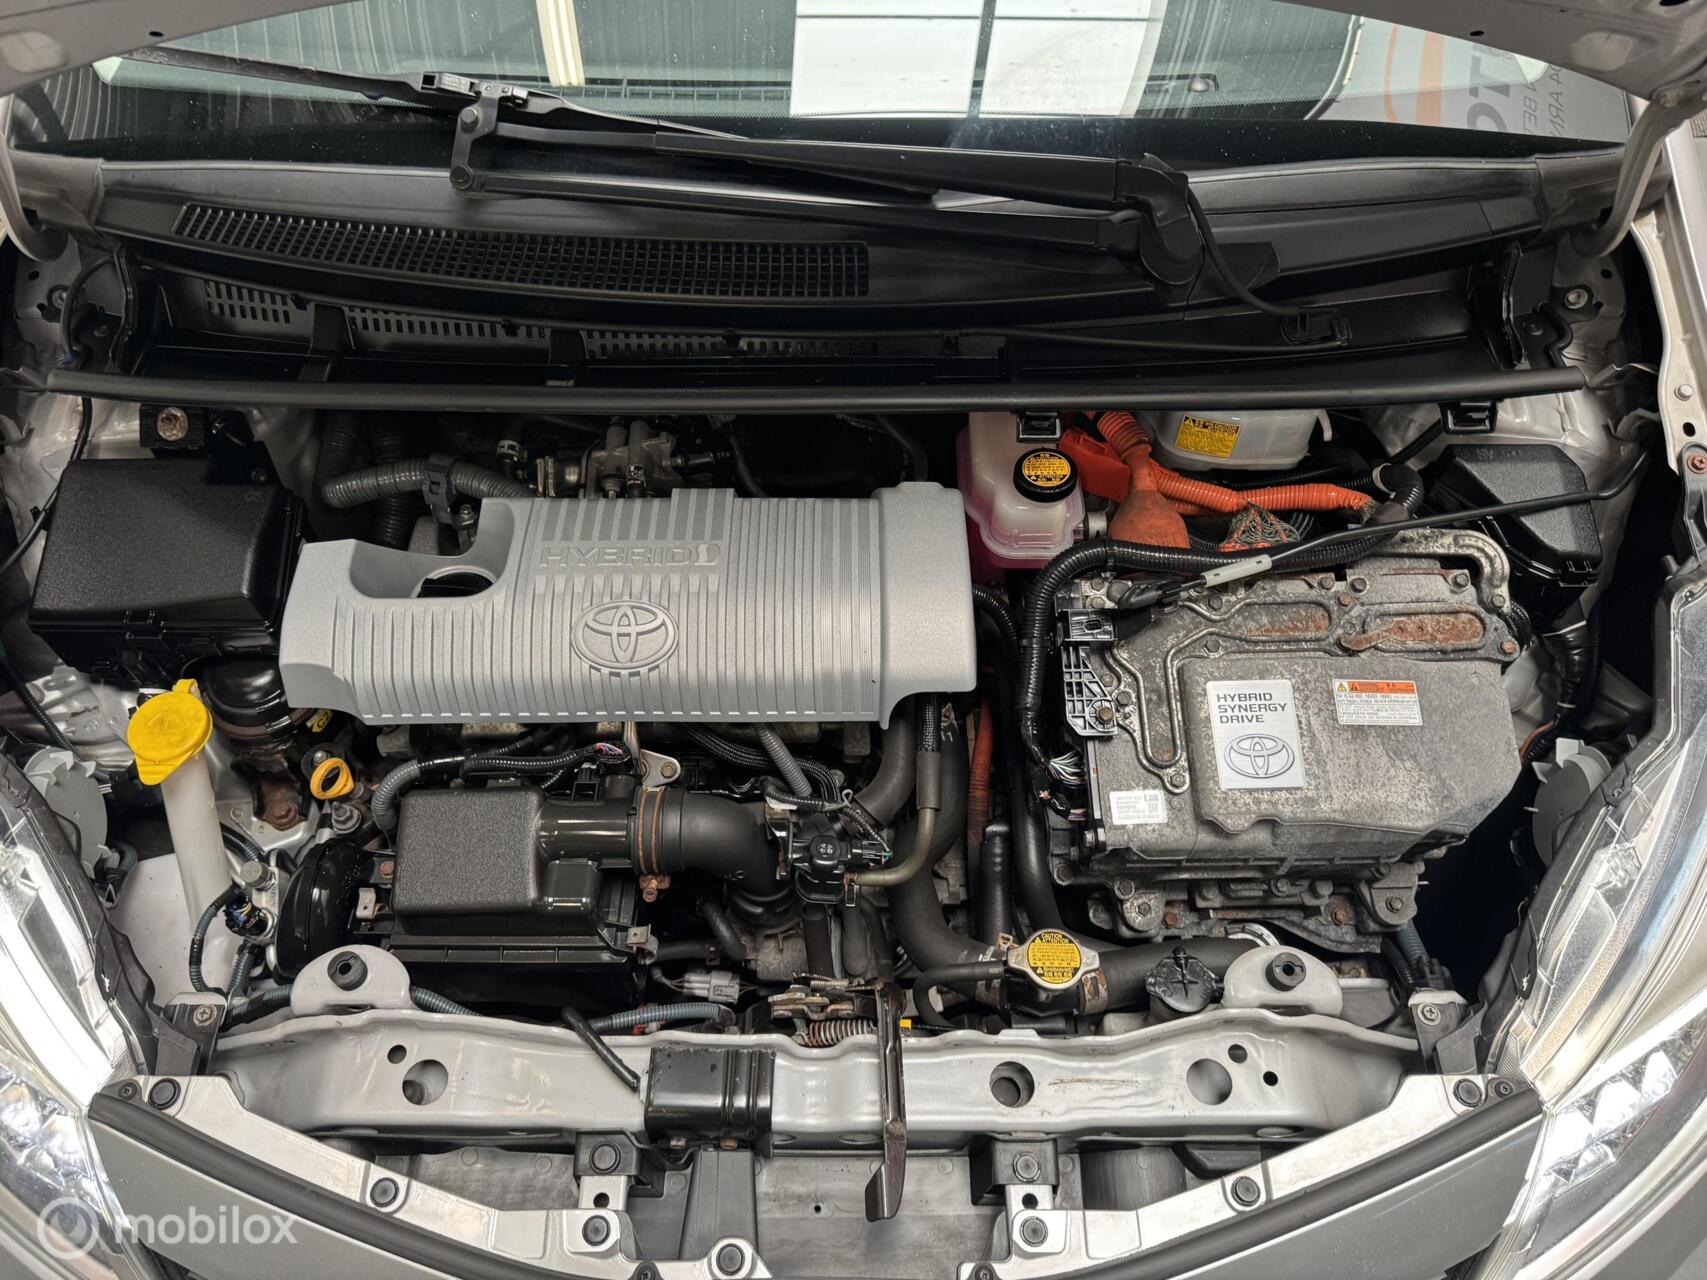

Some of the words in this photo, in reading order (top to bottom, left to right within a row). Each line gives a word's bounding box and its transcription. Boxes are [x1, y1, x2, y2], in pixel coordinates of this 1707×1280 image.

[539, 545, 691, 567] HYBRID
[1216, 692, 1273, 703] HYBRID
[1218, 702, 1288, 714] SYNERGY
[1219, 714, 1265, 724] DRIVE
